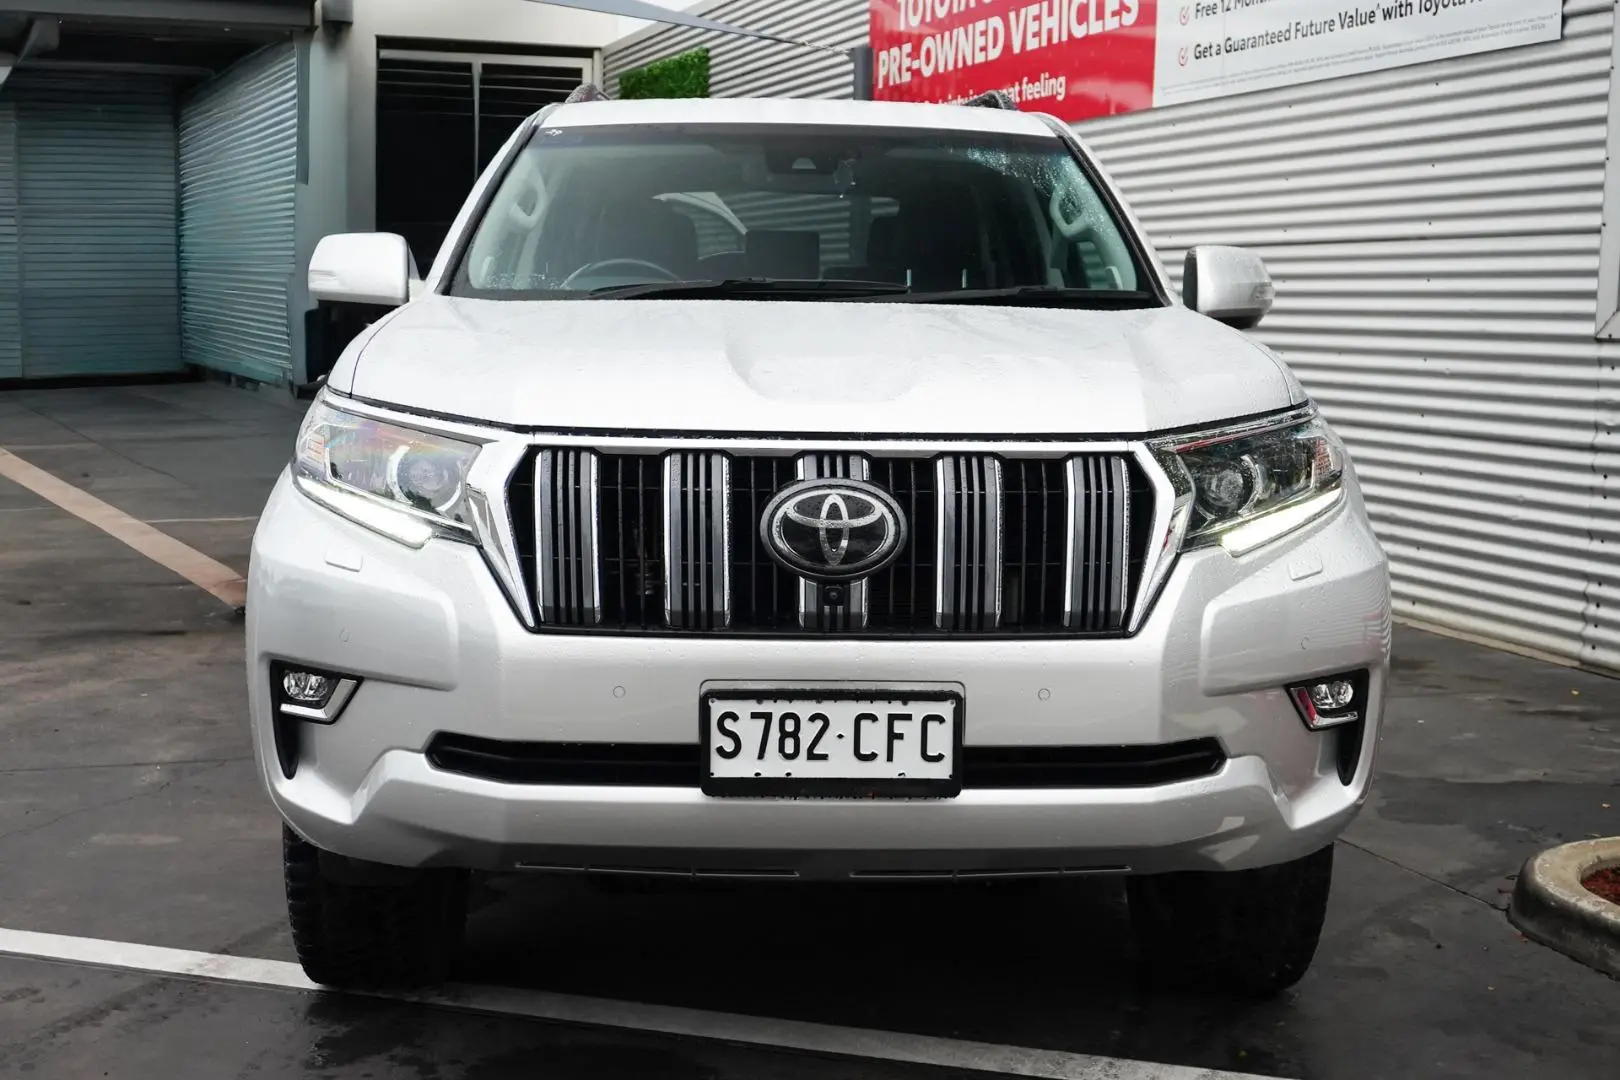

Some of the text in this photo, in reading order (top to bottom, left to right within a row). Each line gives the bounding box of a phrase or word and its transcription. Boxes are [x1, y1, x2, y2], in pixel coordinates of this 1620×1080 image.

[898, 0, 976, 31] TOY
[1195, 3, 1218, 19] Free
[878, 0, 1139, 89] PRE-OWNED VEHICLES
[1194, 43, 1213, 60] Get
[1215, 45, 1222, 55] a
[1224, 23, 1291, 54] Guaranteed
[1295, 18, 1335, 39] Future
[1382, 0, 1412, 21] with
[1022, 72, 1066, 101] feeling
